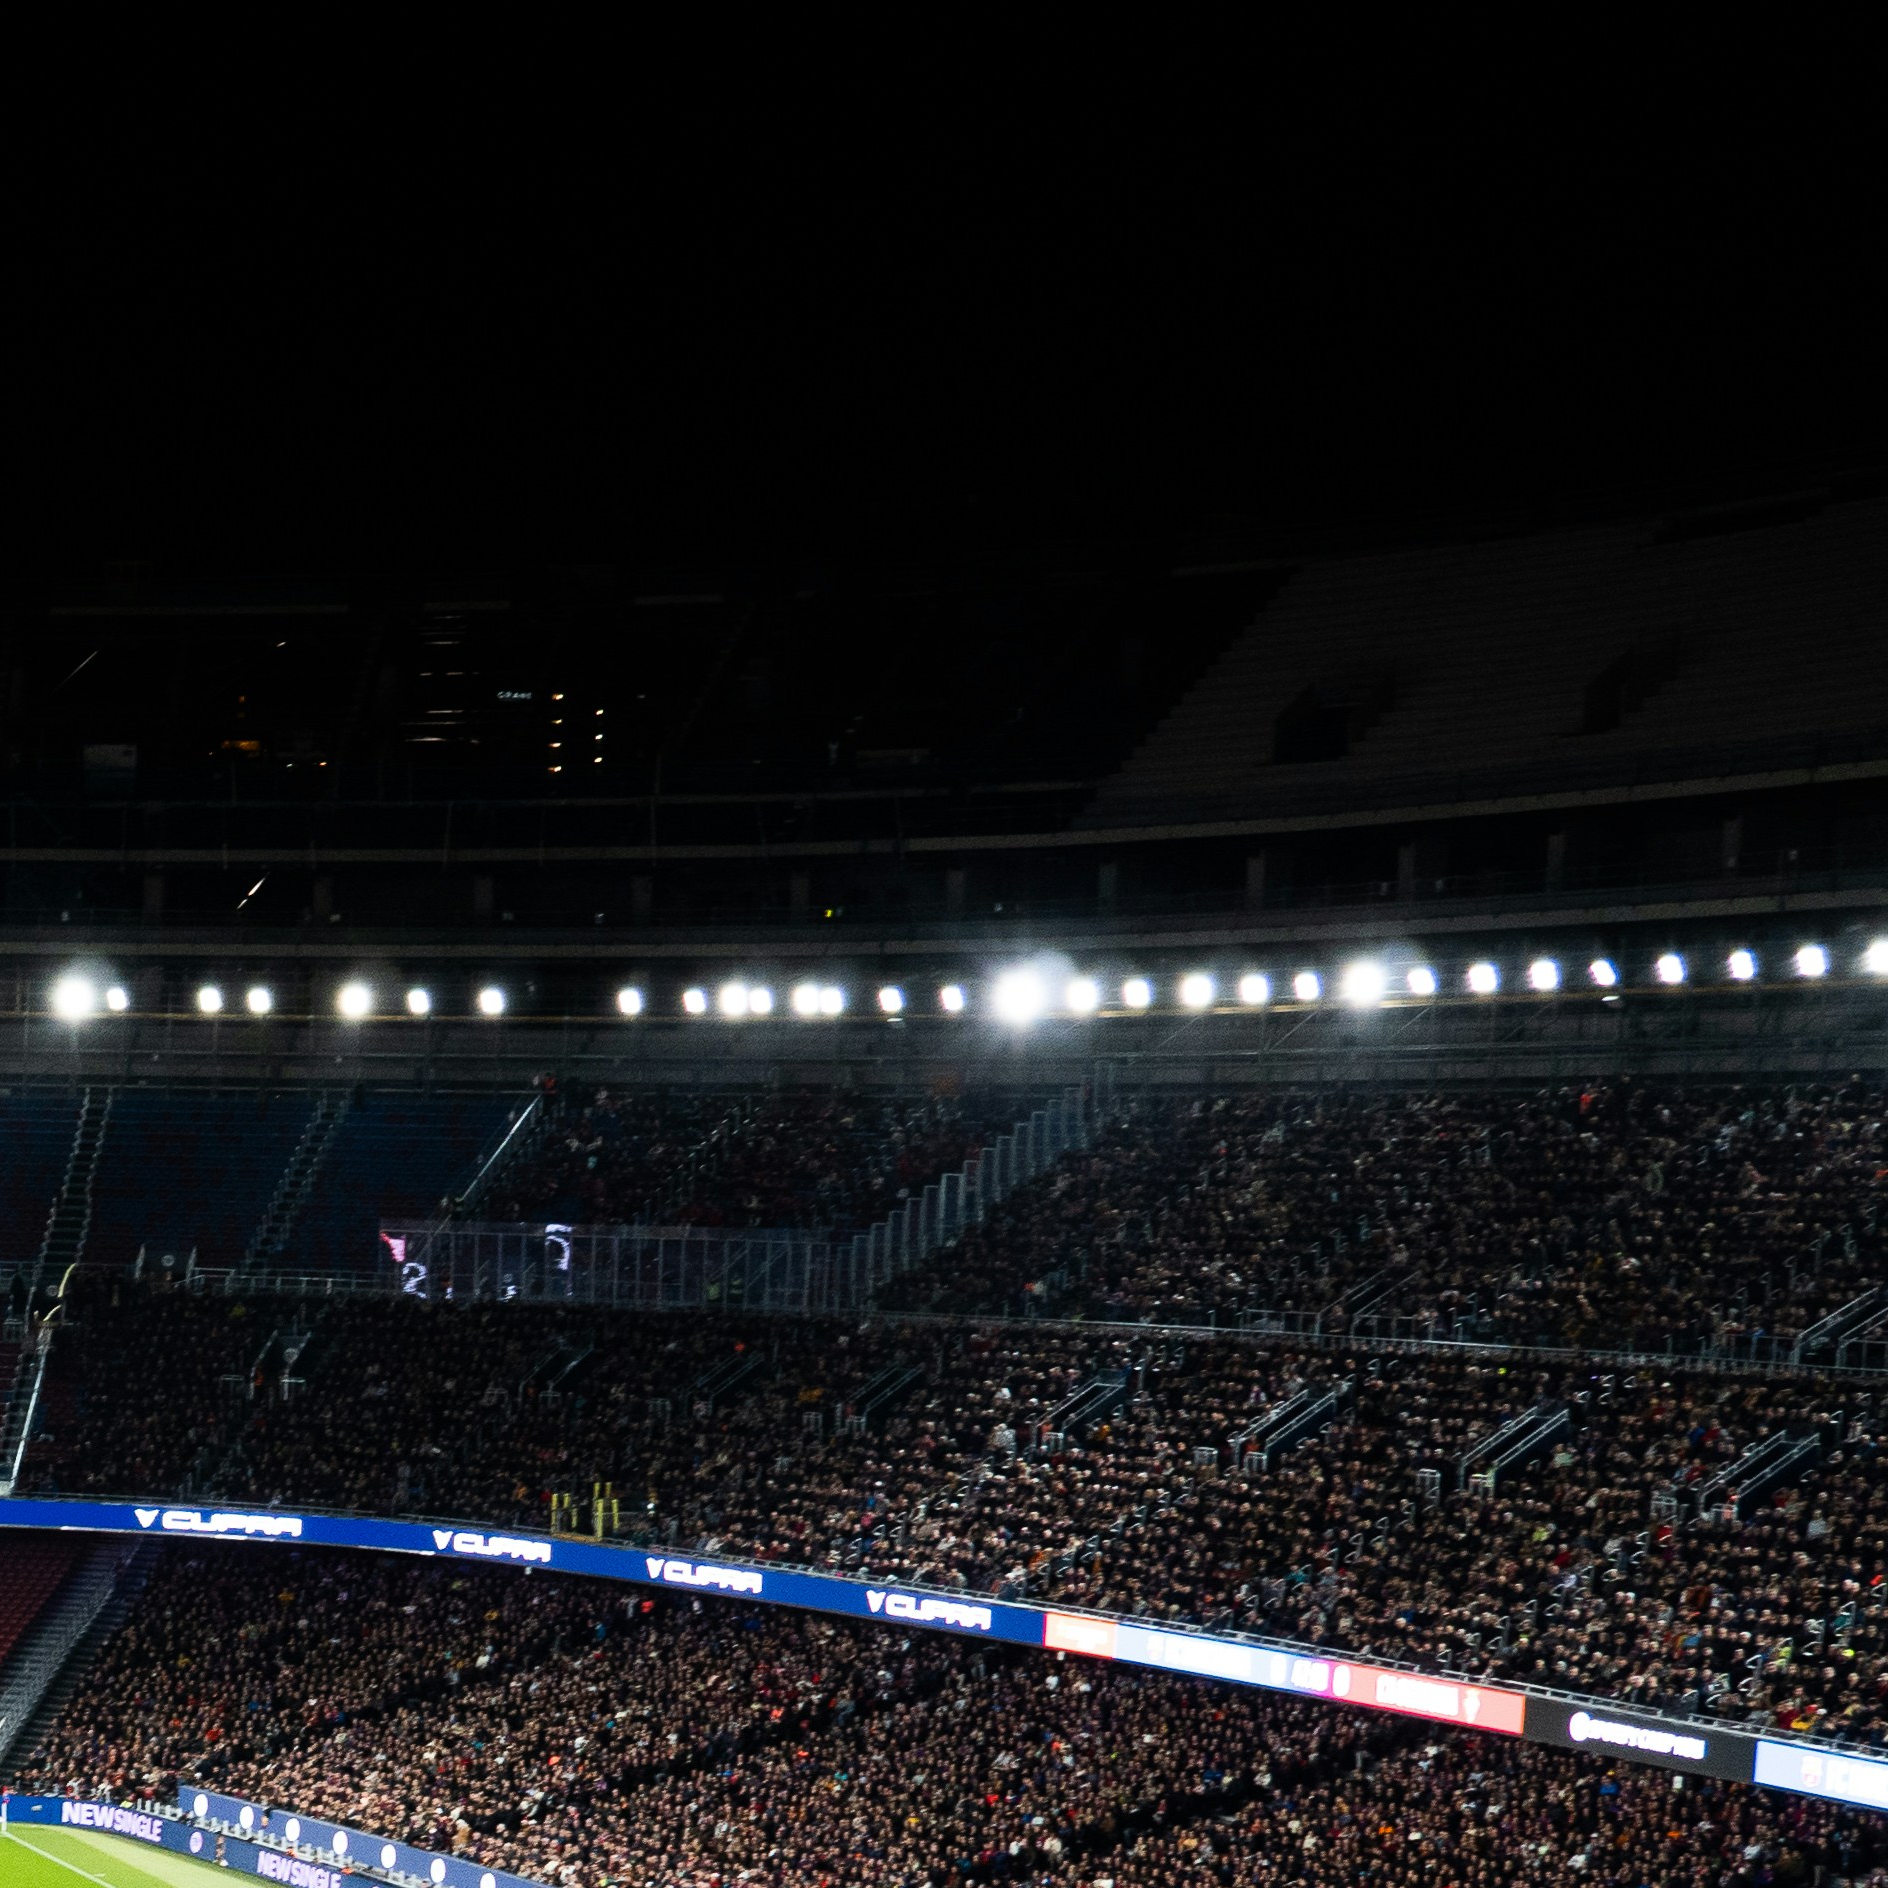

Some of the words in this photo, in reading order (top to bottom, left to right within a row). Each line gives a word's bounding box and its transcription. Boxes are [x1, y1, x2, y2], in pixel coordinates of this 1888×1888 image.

[162, 1511, 302, 1538] CUPRA
[454, 1533, 551, 1562] CUPRA
[661, 1560, 762, 1593] CUPRA
[886, 1595, 993, 1630] CUPRA
[61, 1801, 114, 1828] NEW
[113, 1808, 163, 1842] SINGLE
[257, 1850, 293, 1882] NEW
